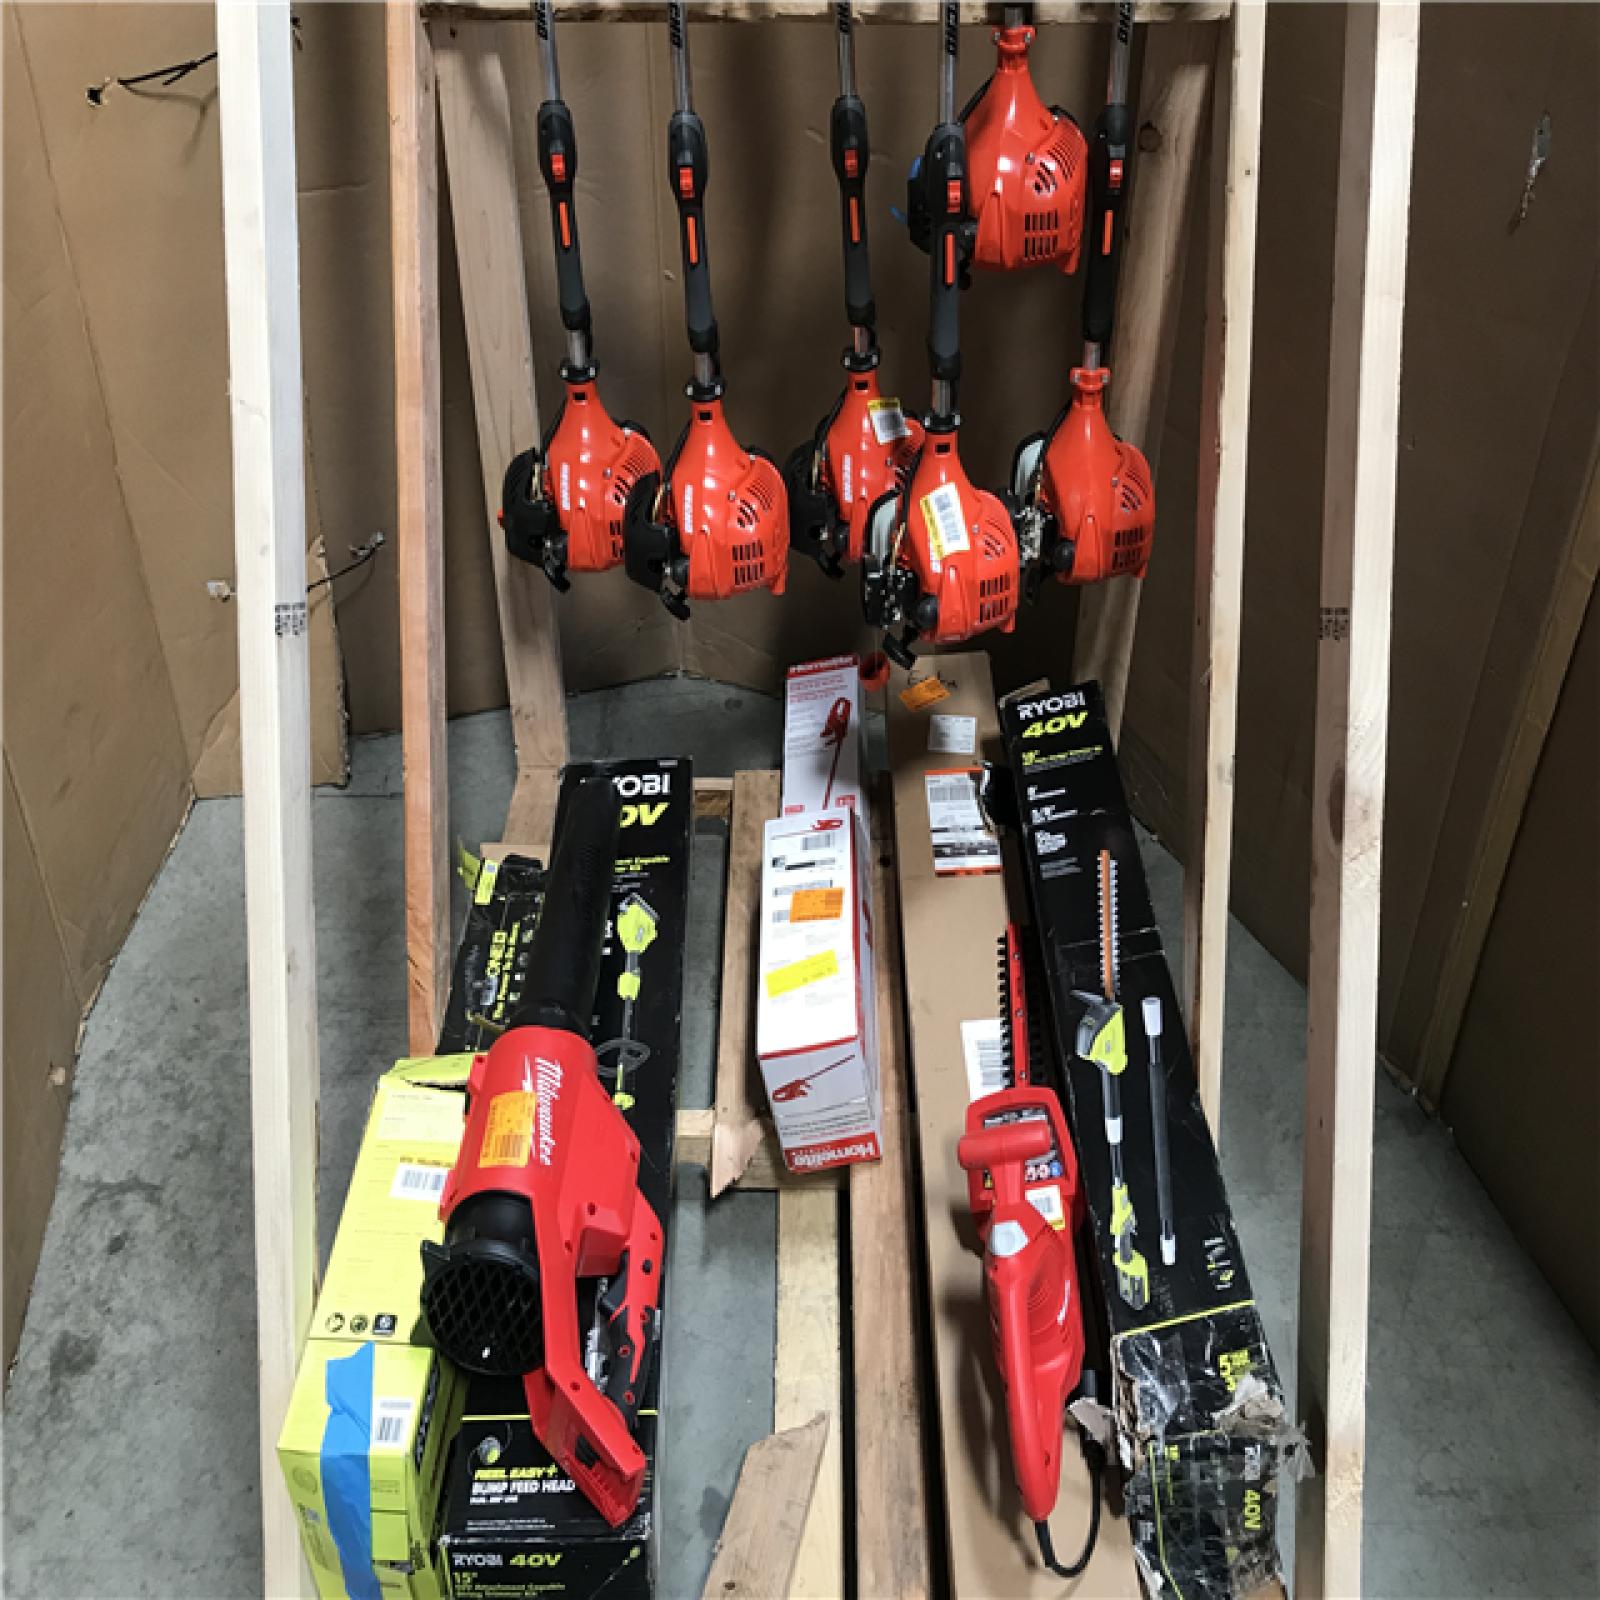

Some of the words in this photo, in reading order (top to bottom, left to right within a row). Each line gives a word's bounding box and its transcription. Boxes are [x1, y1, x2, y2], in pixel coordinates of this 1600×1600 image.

[1017, 690, 1086, 720] RYOBI
[1022, 710, 1089, 738] 40V
[612, 773, 671, 797] OBI
[534, 1056, 564, 1167] Milwaukee
[509, 1553, 564, 1567] 40V
